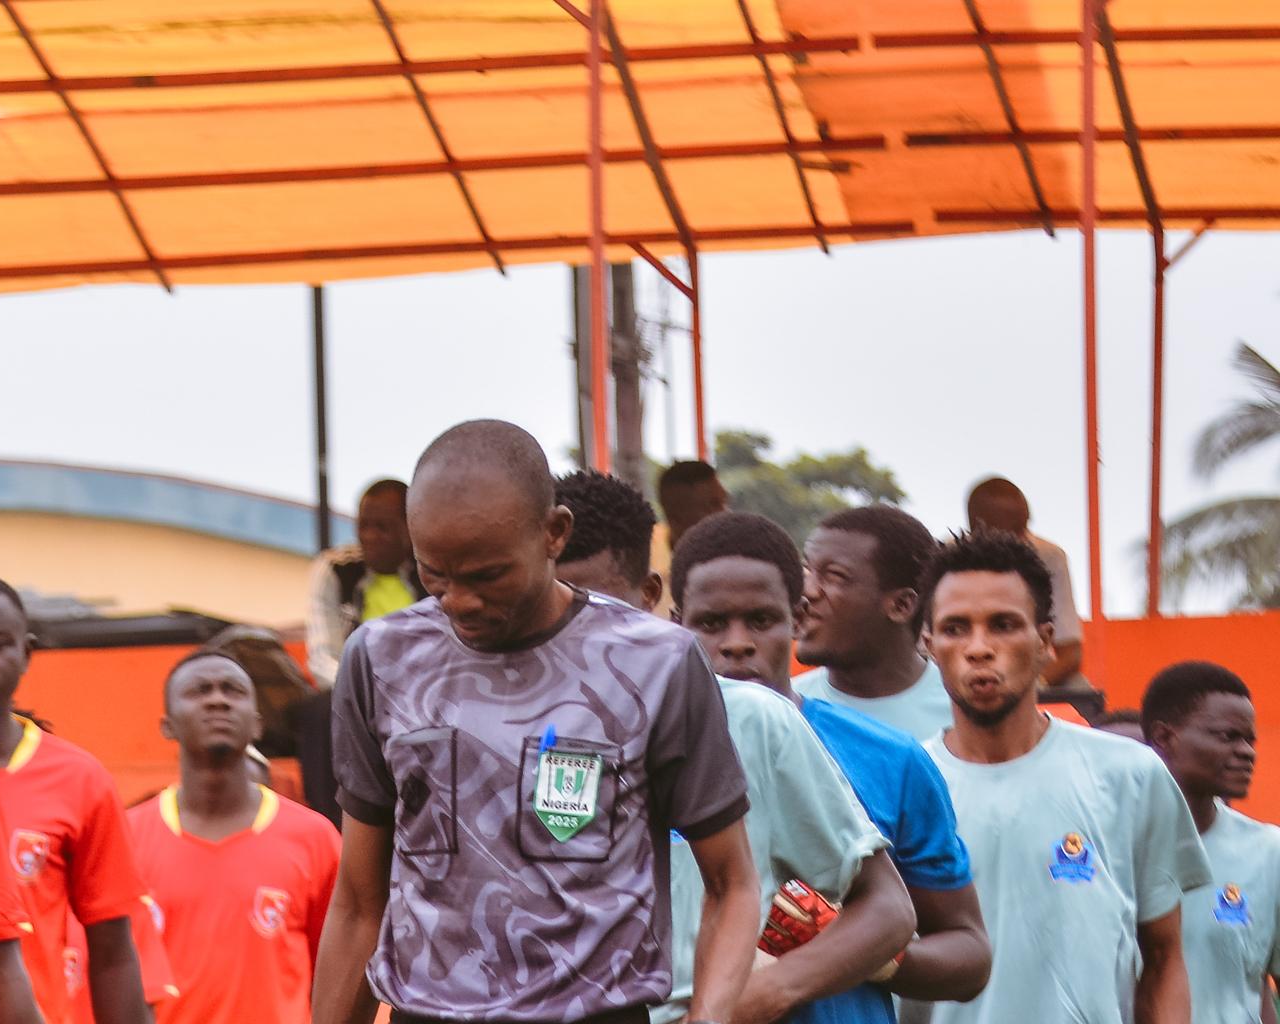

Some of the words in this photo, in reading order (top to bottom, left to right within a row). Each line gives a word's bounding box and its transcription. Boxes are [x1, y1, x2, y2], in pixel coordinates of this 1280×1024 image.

[544, 757, 596, 770] REFEREE
[542, 799, 589, 812] NIGERIA
[547, 813, 579, 829] 2025
